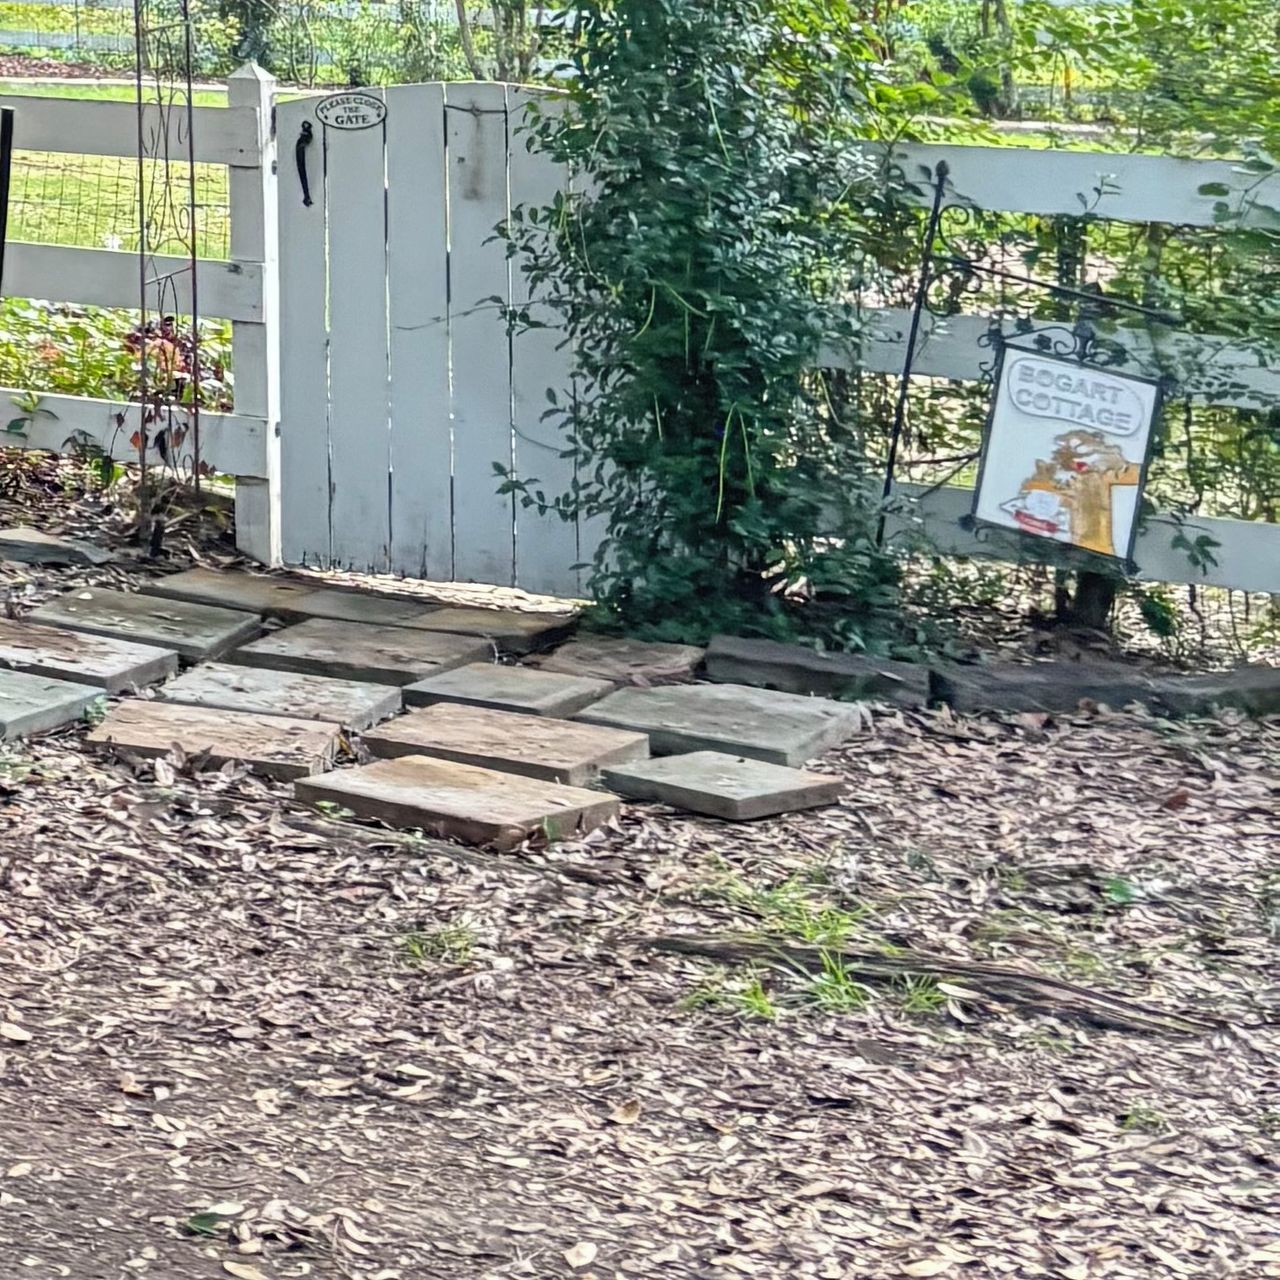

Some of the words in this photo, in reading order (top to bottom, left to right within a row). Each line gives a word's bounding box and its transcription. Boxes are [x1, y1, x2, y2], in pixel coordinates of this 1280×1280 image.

[320, 97, 352, 114] PLEASE
[353, 97, 383, 112] CLOSE
[335, 115, 370, 125] GATE
[1018, 363, 1123, 404] BOGART
[1016, 388, 1132, 431] COTTAGE
